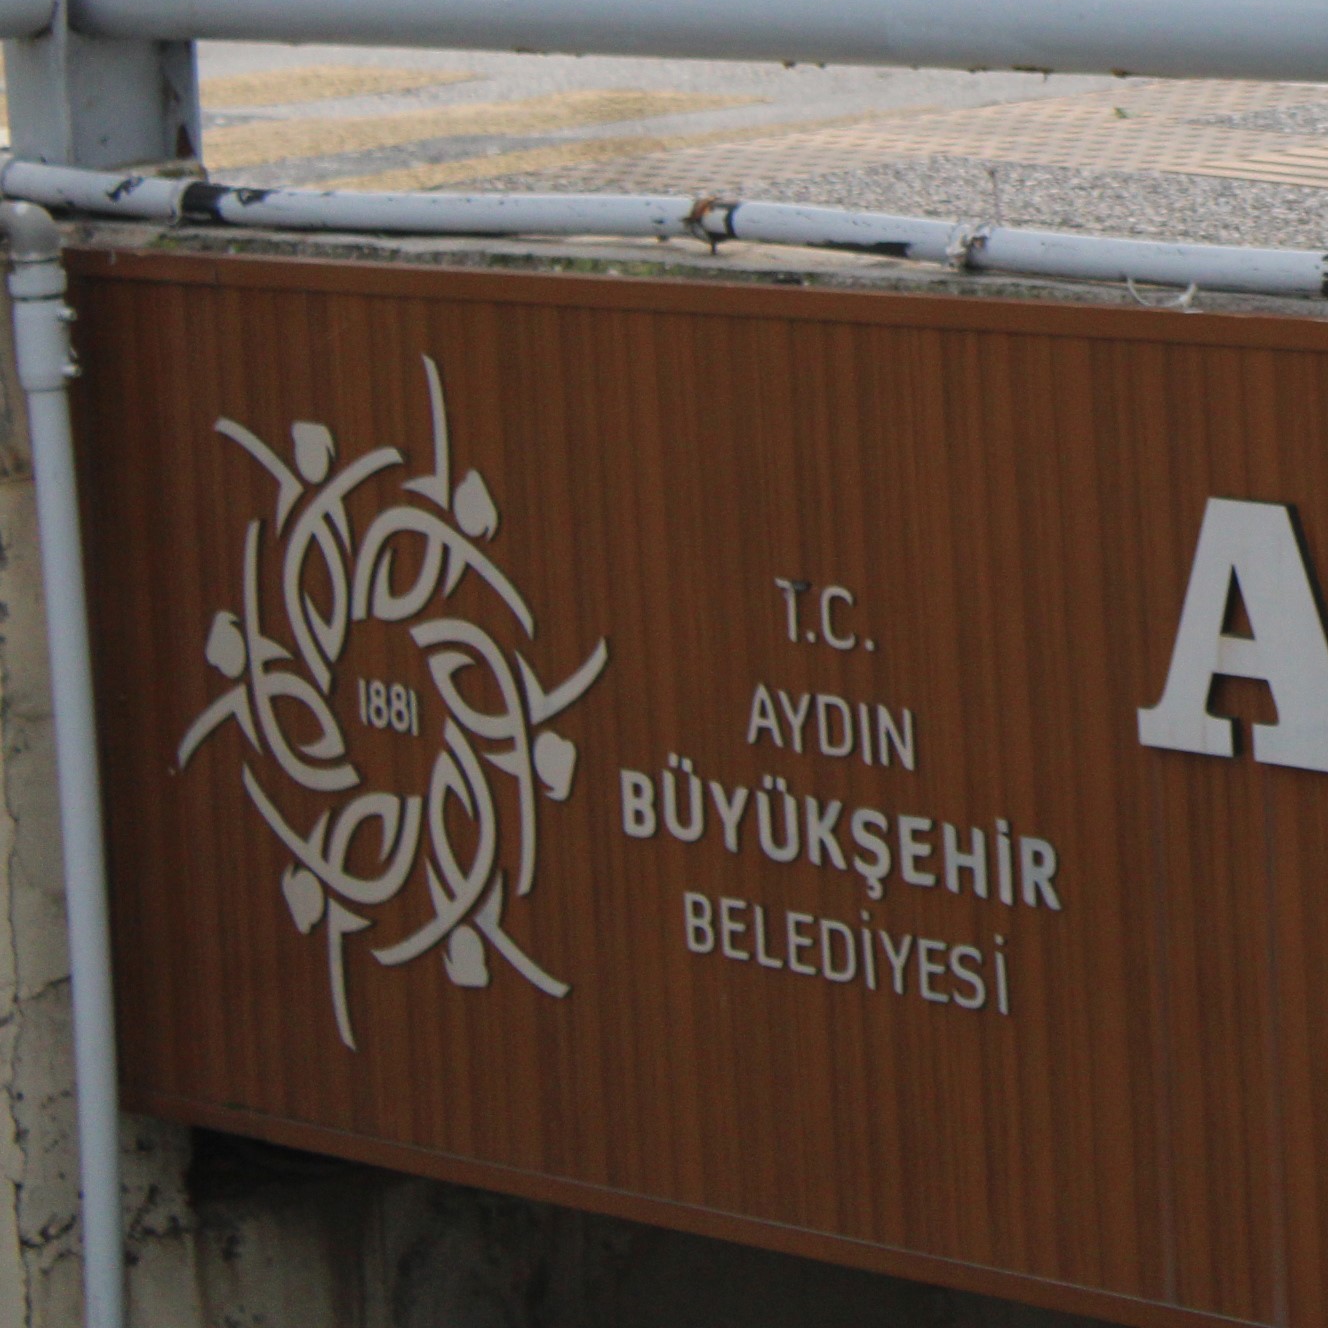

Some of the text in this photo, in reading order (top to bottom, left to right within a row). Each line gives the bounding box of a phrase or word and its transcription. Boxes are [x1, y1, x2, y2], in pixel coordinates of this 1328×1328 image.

[775, 577, 875, 651] T.C.
[358, 677, 419, 737] 1881
[747, 683, 915, 771] AYDIN
[620, 752, 1062, 910] BÜYÜKŞEHİR
[684, 891, 1009, 1015] BELEDİYESİ
